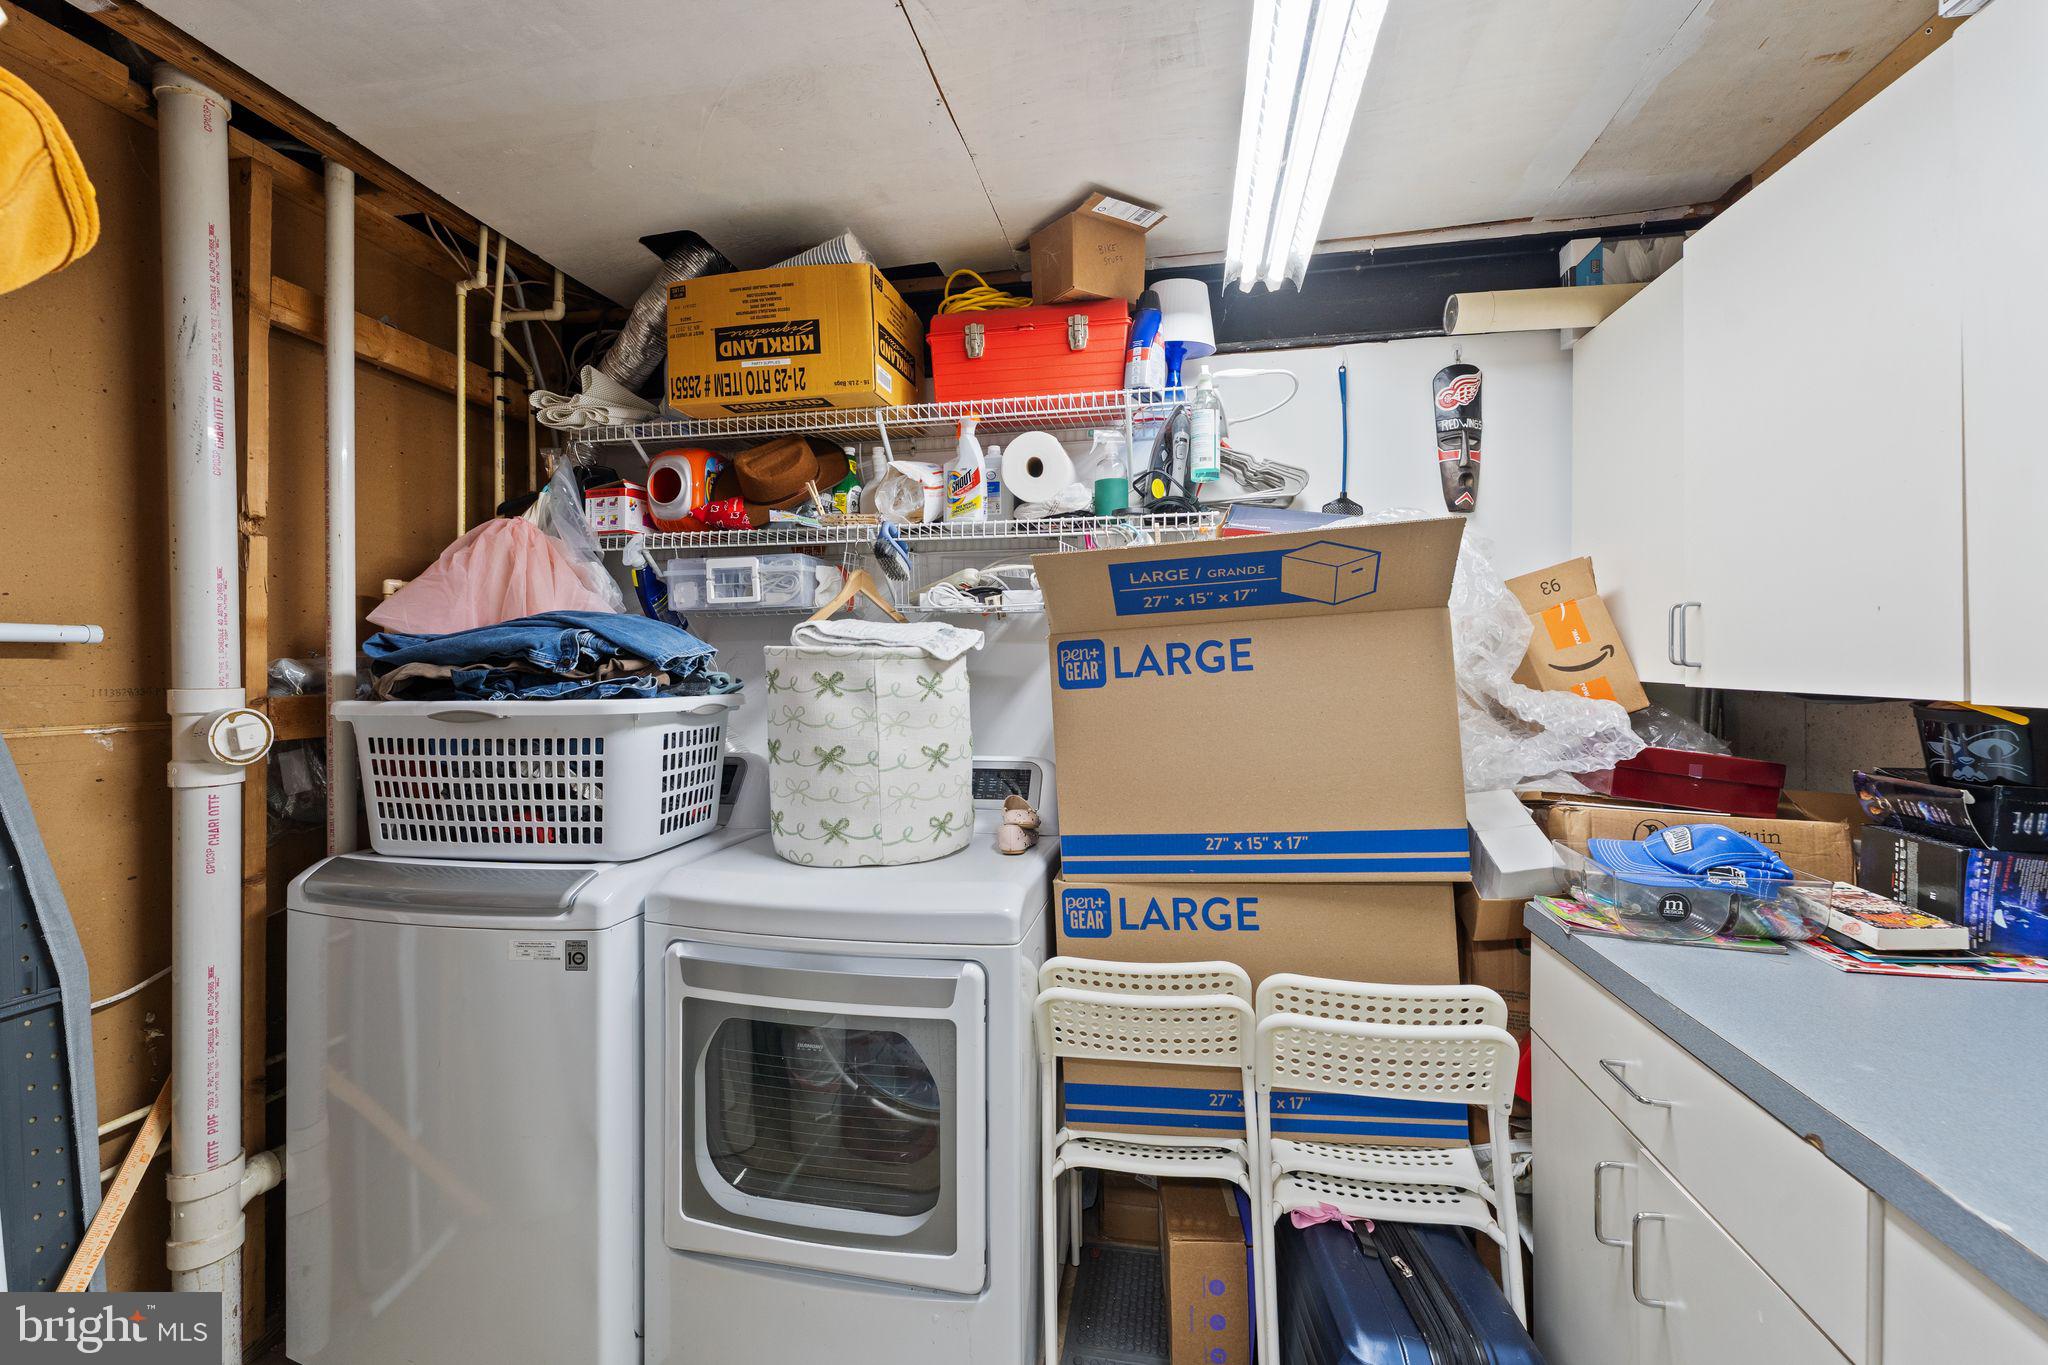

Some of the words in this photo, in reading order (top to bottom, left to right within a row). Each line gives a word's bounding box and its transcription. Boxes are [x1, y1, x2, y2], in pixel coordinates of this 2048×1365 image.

[1097, 243, 1117, 255] BIKE
[718, 320, 814, 337] Signature
[719, 333, 815, 357] KIRKLAND
[670, 376, 702, 400] 25551
[704, 374, 711, 397] #
[714, 372, 743, 397] ITEM
[746, 370, 771, 396] RTO
[774, 367, 806, 392] 21-25
[728, 399, 824, 410] KIRKLAND
[1440, 418, 1460, 431] RED
[1458, 418, 1483, 430] WINGS
[951, 469, 972, 493] SHOUT
[1129, 568, 1190, 585] LARGE
[1207, 564, 1266, 579] GRANDE
[1540, 578, 1561, 596] 93
[1143, 594, 1170, 609] 27"
[1174, 597, 1184, 606] x
[1188, 591, 1214, 606] 15"
[1218, 594, 1228, 603] x
[1233, 588, 1259, 601] 17"
[1060, 647, 1100, 670] pen+
[1113, 637, 1254, 679] LARGE
[1065, 661, 1100, 681] GEAR
[1205, 837, 1229, 851] 27"
[1233, 841, 1243, 850] x
[1246, 836, 1269, 851] 15"
[1273, 840, 1283, 850] x
[1287, 836, 1309, 850] 17"
[1738, 829, 1782, 846] guin
[1064, 896, 1105, 918] pen+
[1119, 896, 1261, 931] LARGE
[1069, 910, 1104, 930] GEAR
[567, 951, 586, 965] 10
[1208, 1093, 1233, 1107] 27"
[1276, 1099, 1285, 1109] x
[1288, 1096, 1311, 1110] 17"
[103, 1201, 127, 1238] PAINTS
